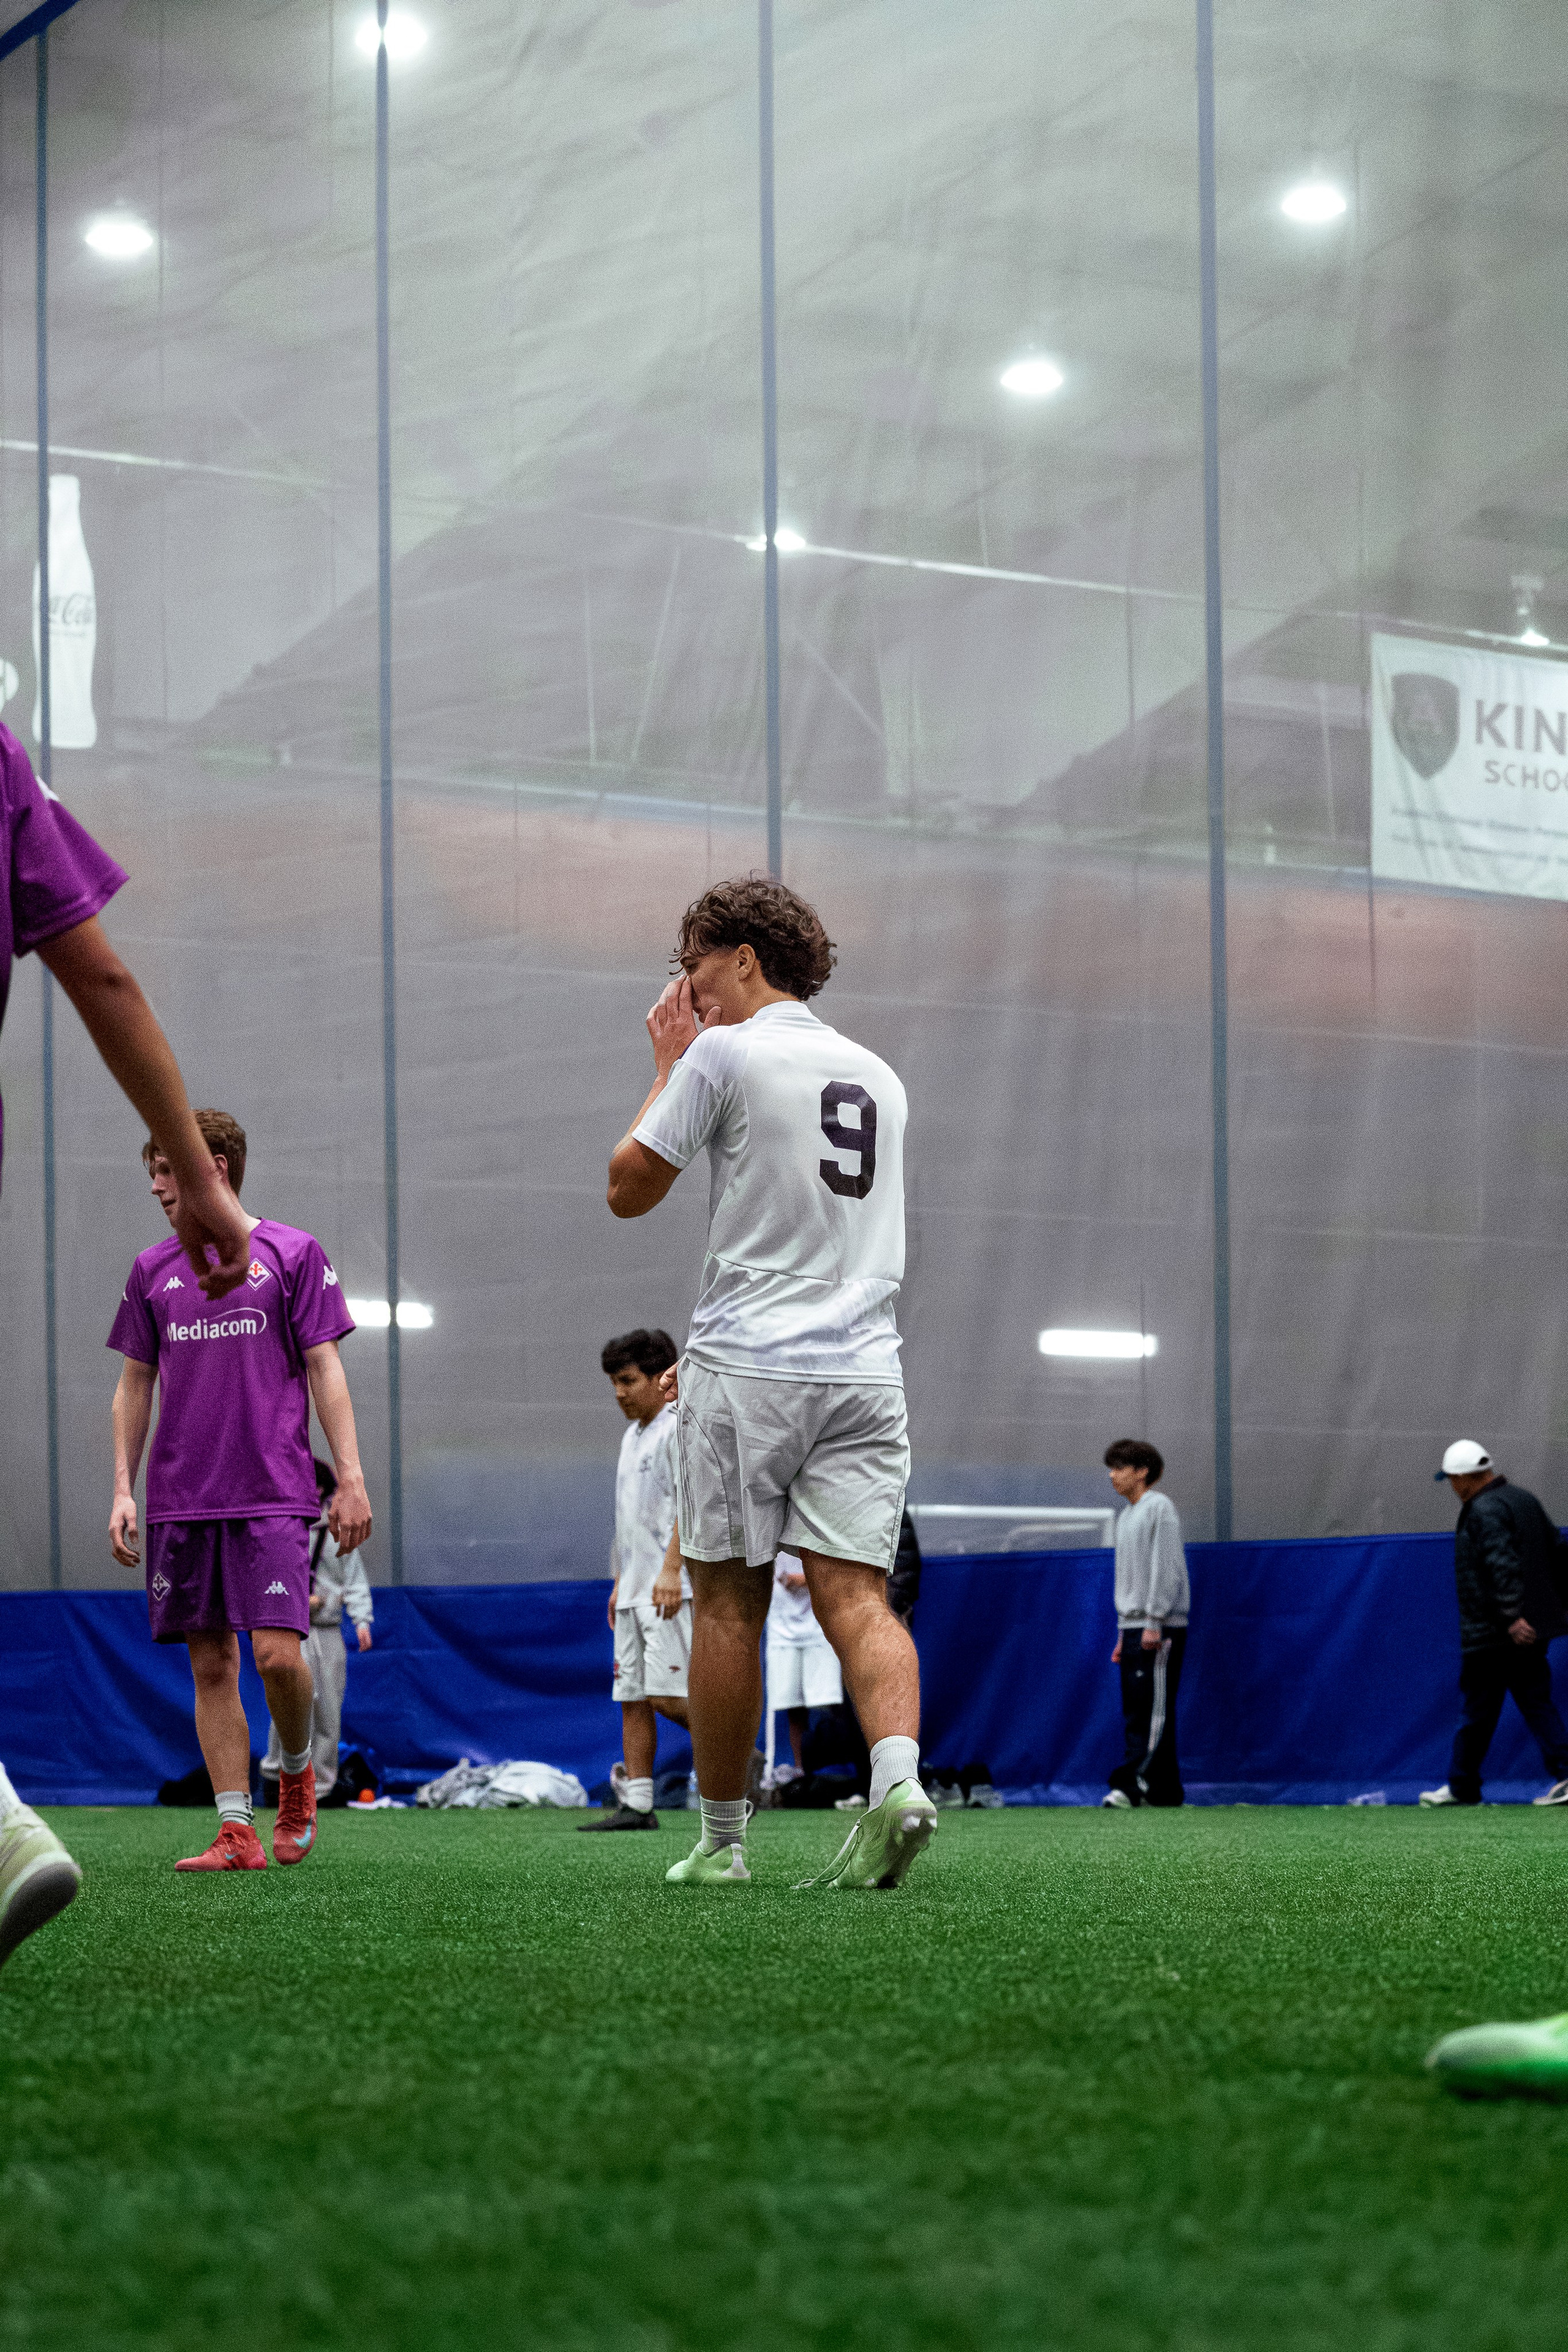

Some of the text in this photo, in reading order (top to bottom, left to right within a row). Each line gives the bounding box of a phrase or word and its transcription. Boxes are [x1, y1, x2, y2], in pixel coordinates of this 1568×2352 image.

[1476, 698, 1567, 756] KIN
[1485, 760, 1568, 792] SCHO
[820, 1080, 876, 1199] 9
[167, 1318, 257, 1342] Mediacom
